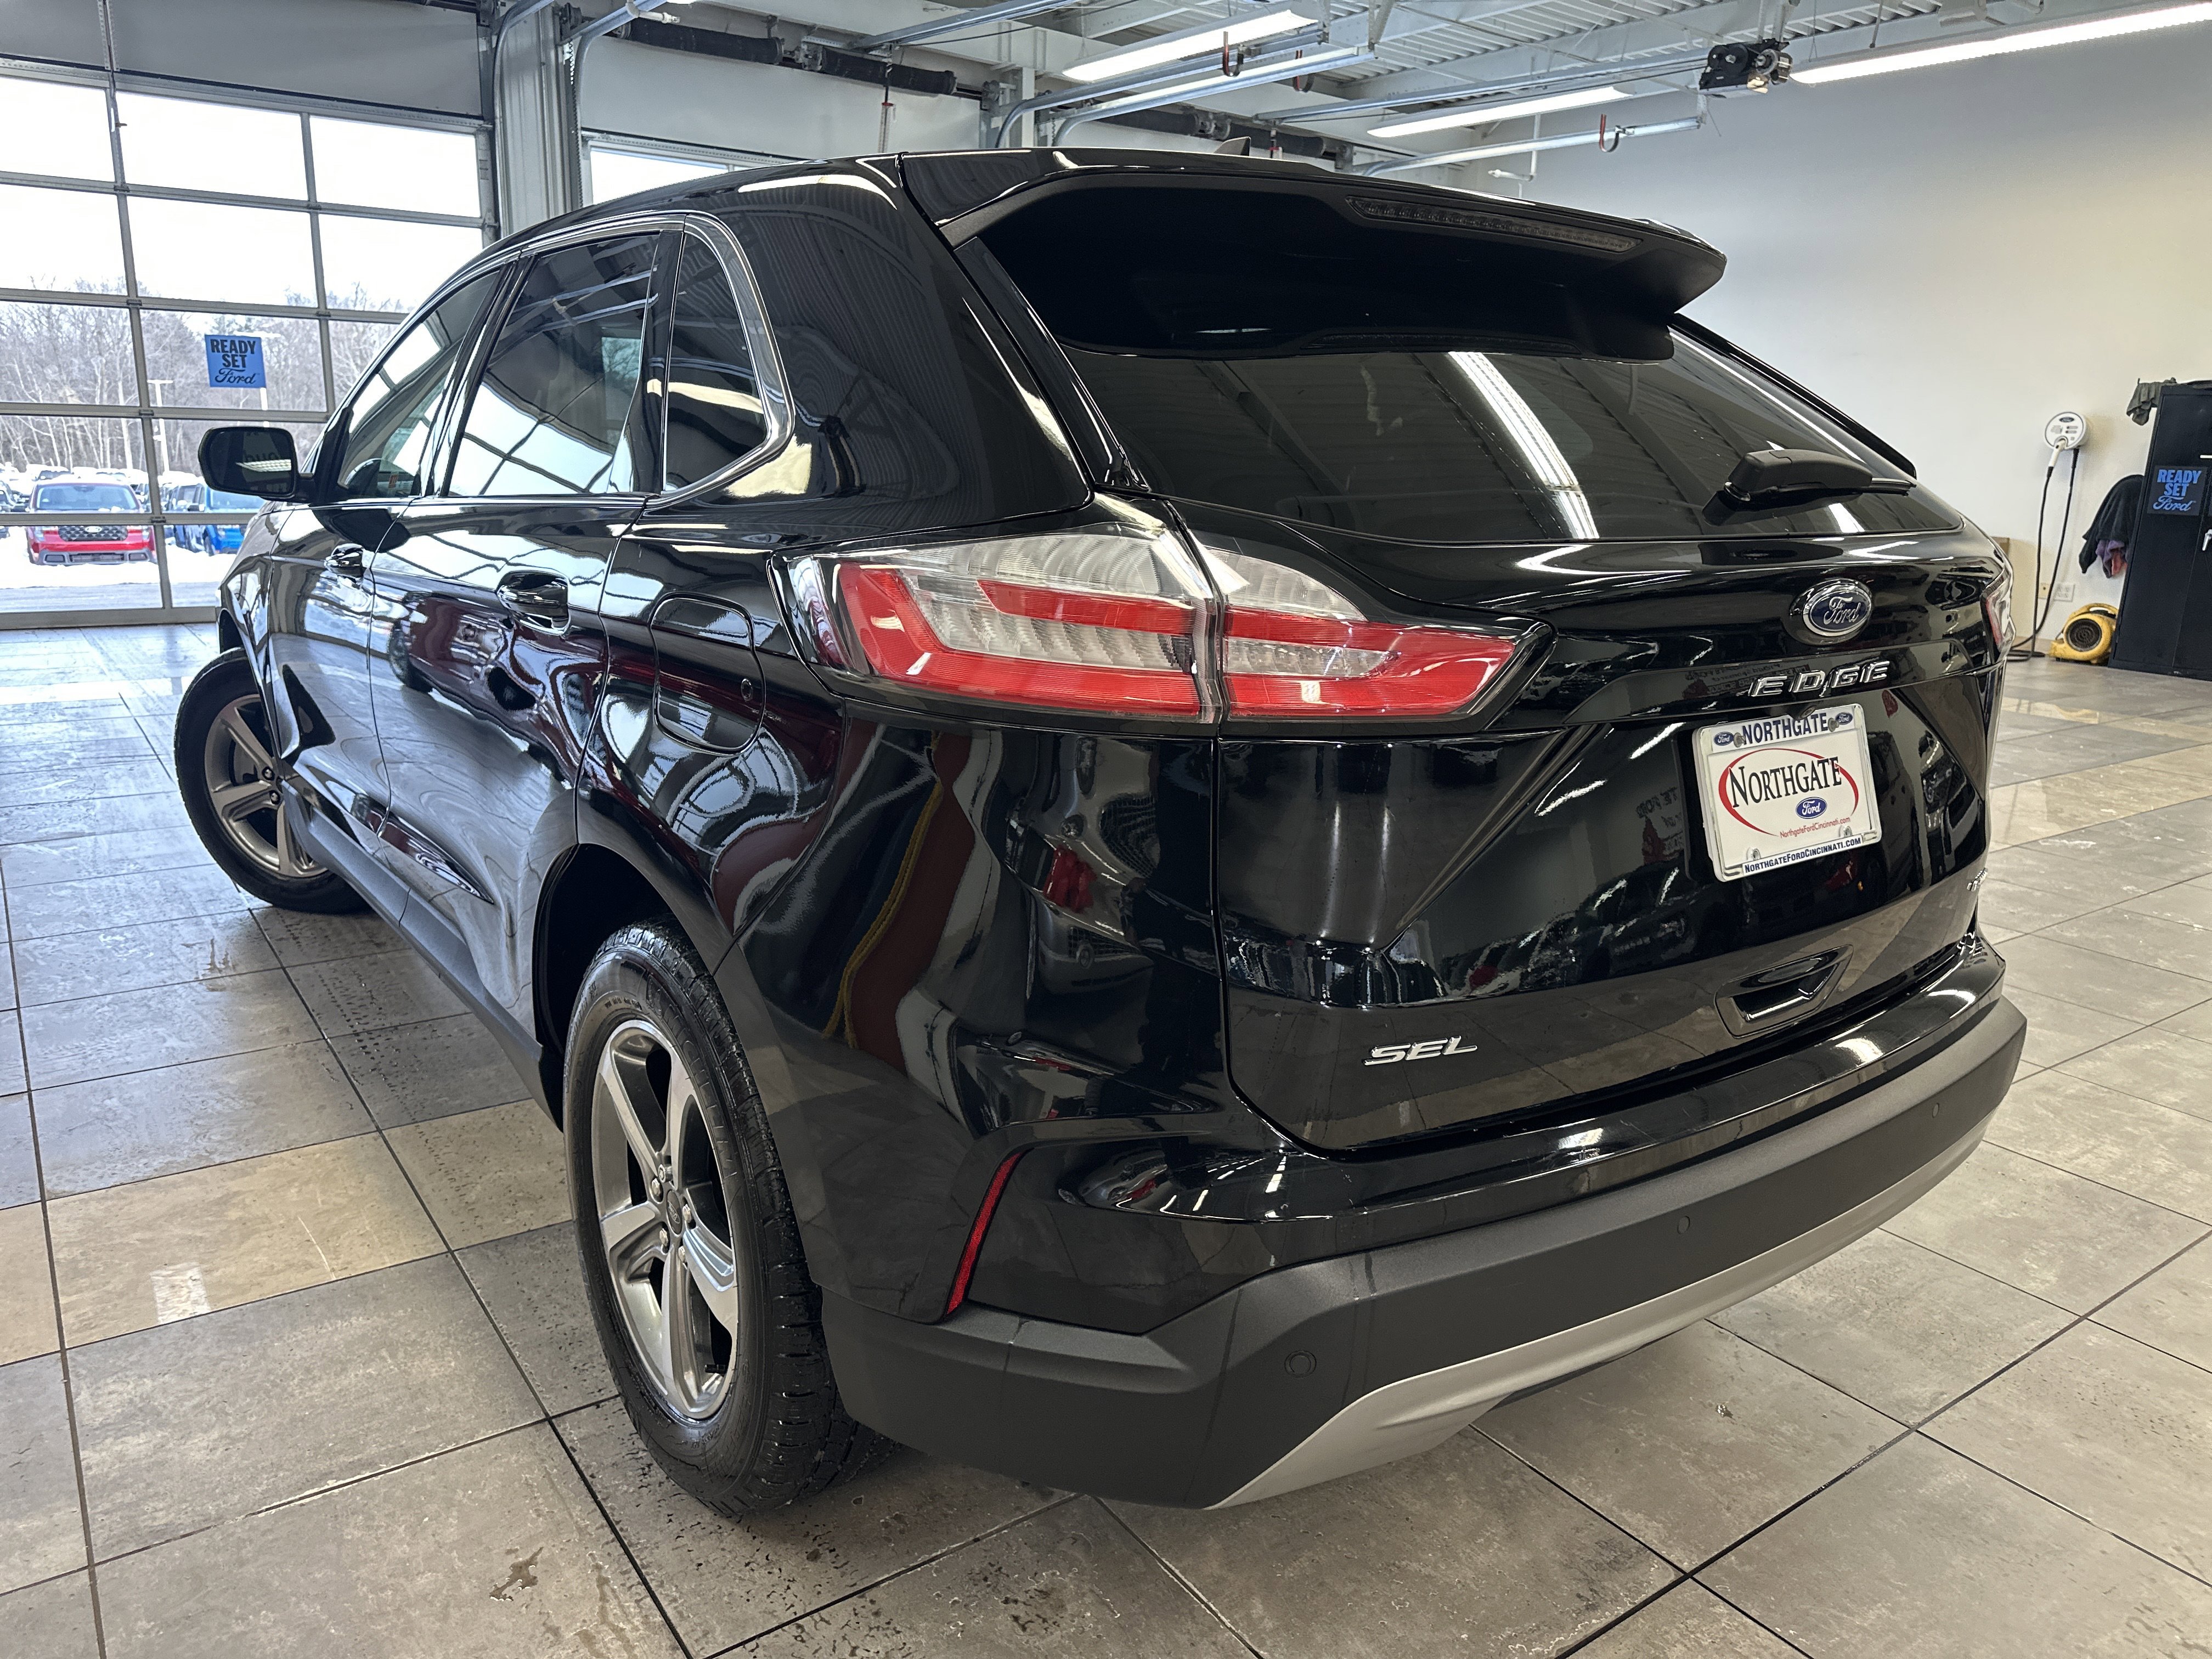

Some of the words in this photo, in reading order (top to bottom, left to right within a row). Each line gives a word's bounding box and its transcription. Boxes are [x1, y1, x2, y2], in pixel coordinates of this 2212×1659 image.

[210, 338, 256, 354] READY
[222, 353, 247, 368] SET
[215, 368, 256, 384] Ford
[2157, 469, 2202, 484] READY
[2164, 483, 2189, 496] SET
[2153, 495, 2193, 511] Ford
[1823, 596, 1861, 625] Ford
[1748, 661, 1890, 697] EDGE
[1742, 713, 1829, 745] NORTHGATE
[1729, 757, 1842, 808] NORTHGATE
[1802, 800, 1821, 815] Ford
[1780, 816, 1851, 838] NorthgateFordCincinnati.com
[1363, 1035, 1477, 1065] SEL
